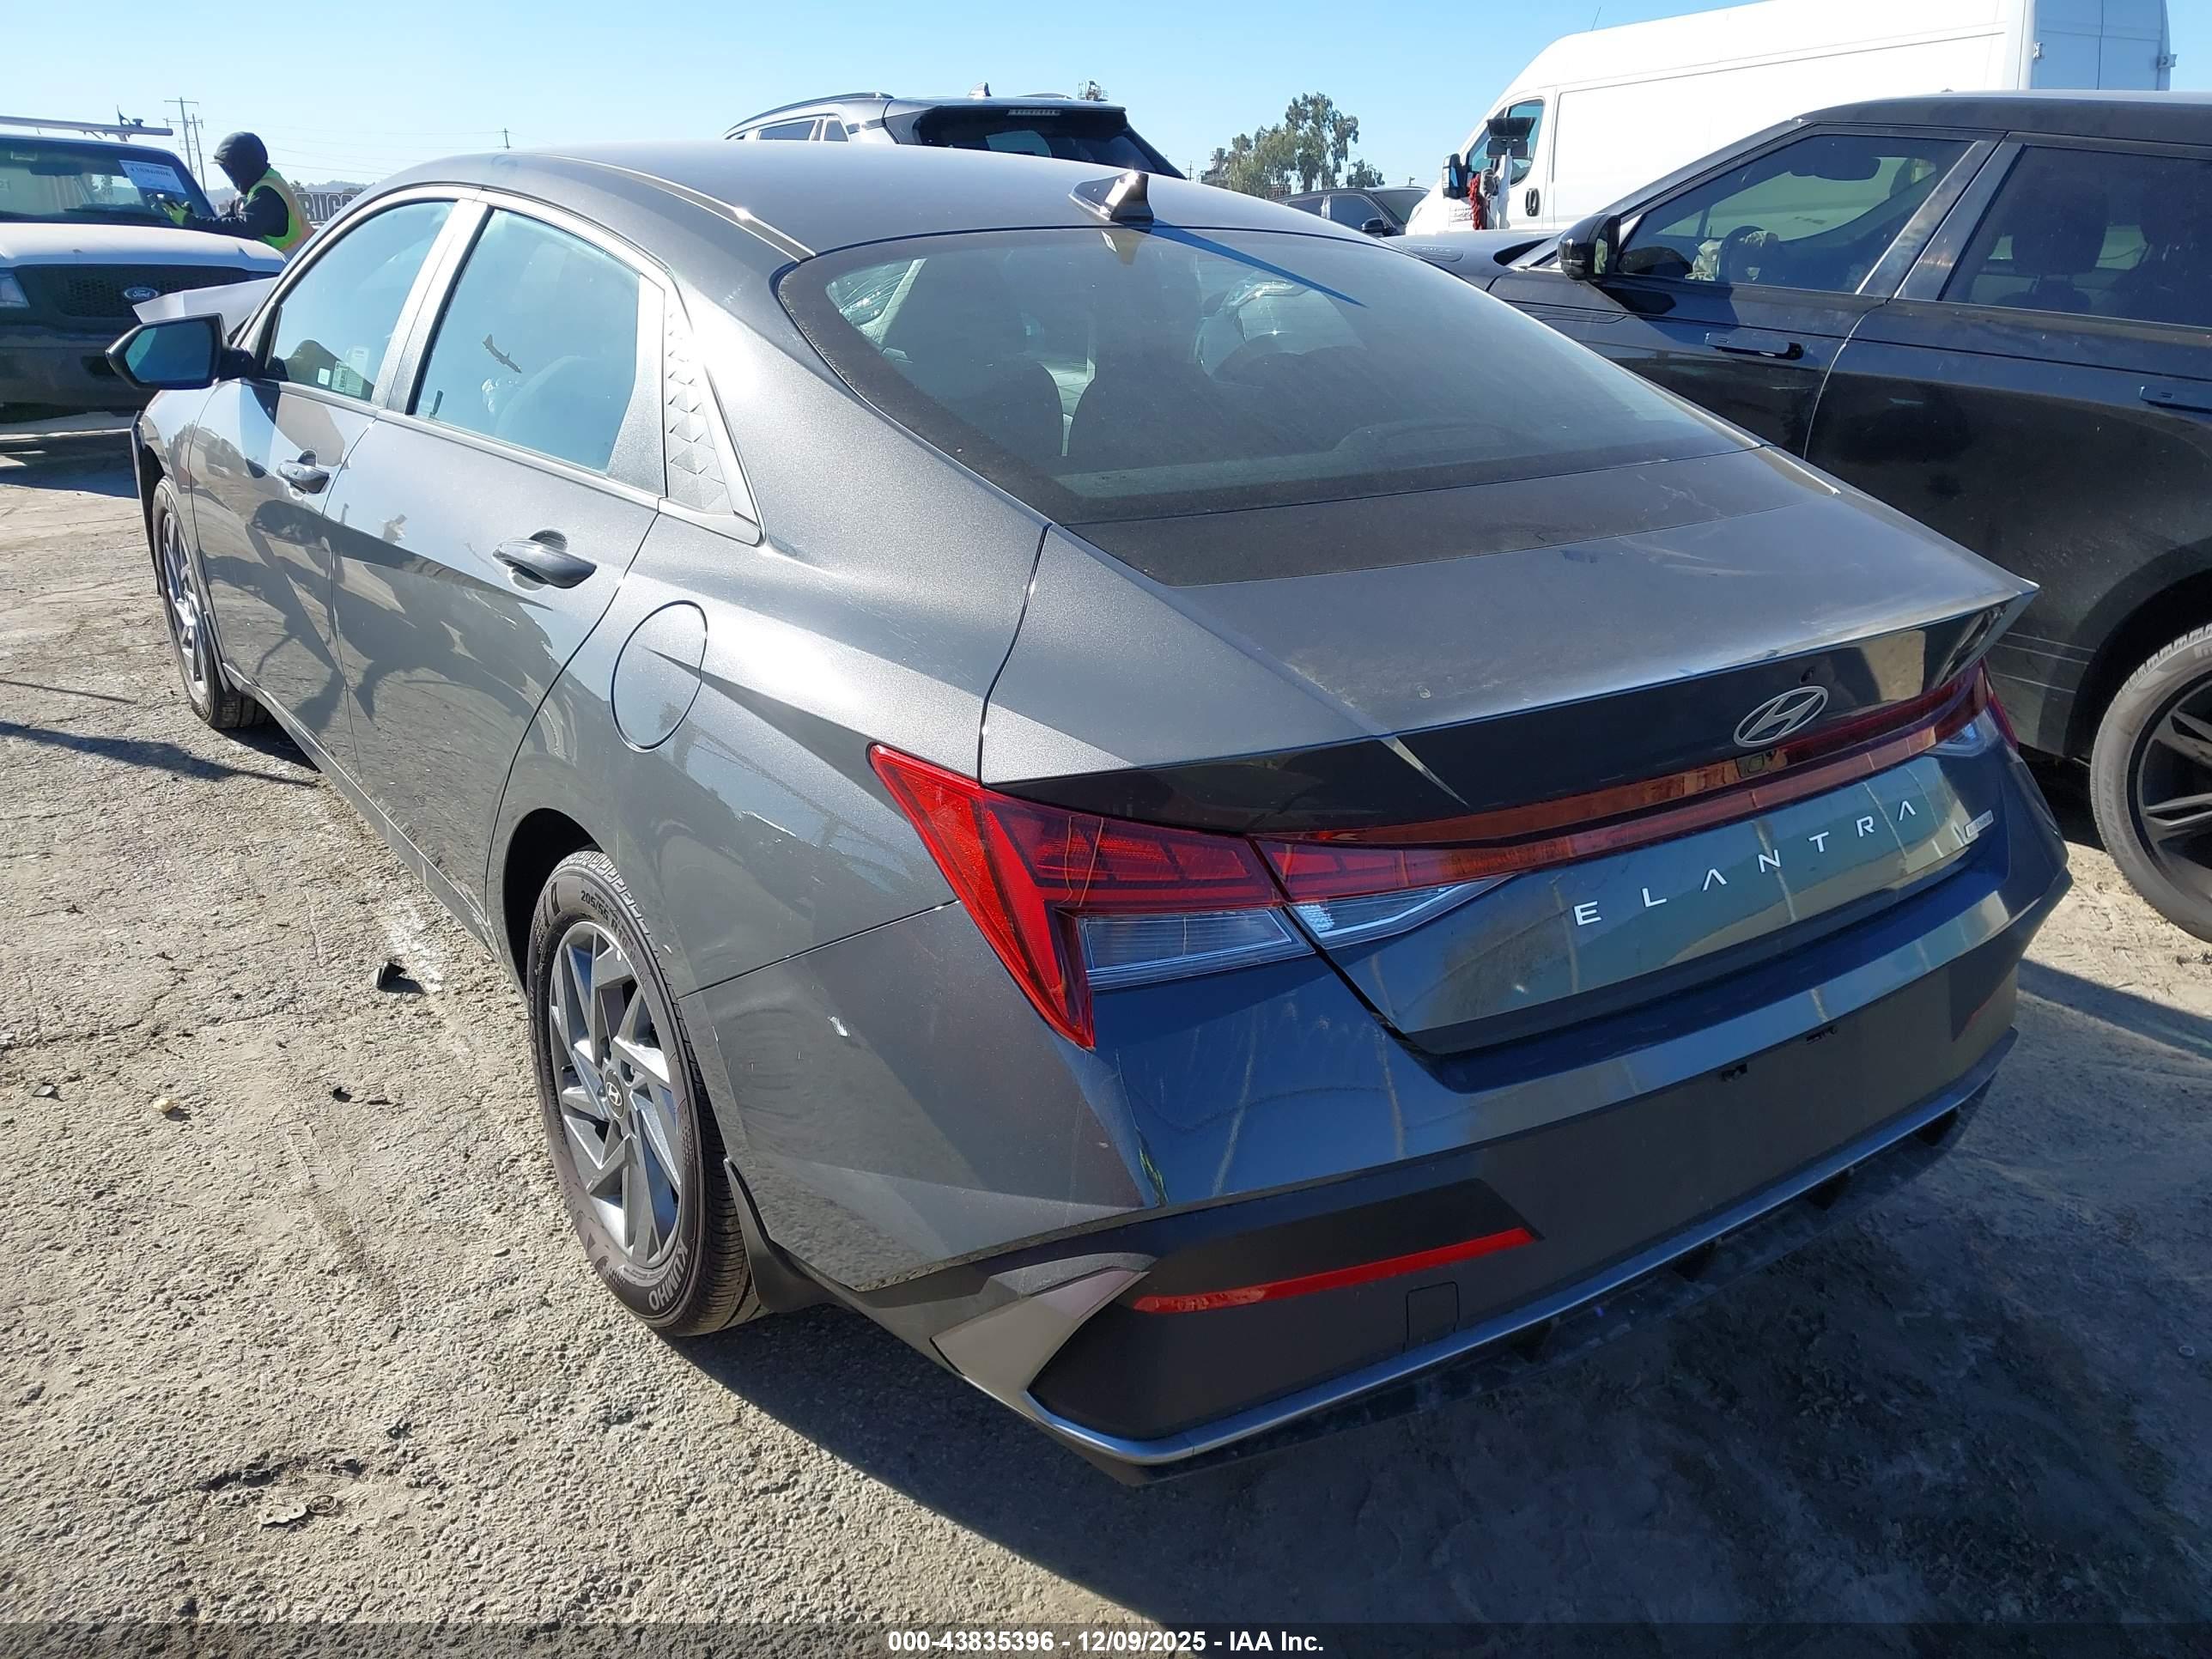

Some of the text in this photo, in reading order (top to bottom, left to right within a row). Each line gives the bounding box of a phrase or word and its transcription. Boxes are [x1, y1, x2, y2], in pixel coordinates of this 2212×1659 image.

[1572, 799, 1917, 926] ELANTRA
[580, 890, 610, 921] 205/55
[647, 1237, 689, 1311] KUMHO
